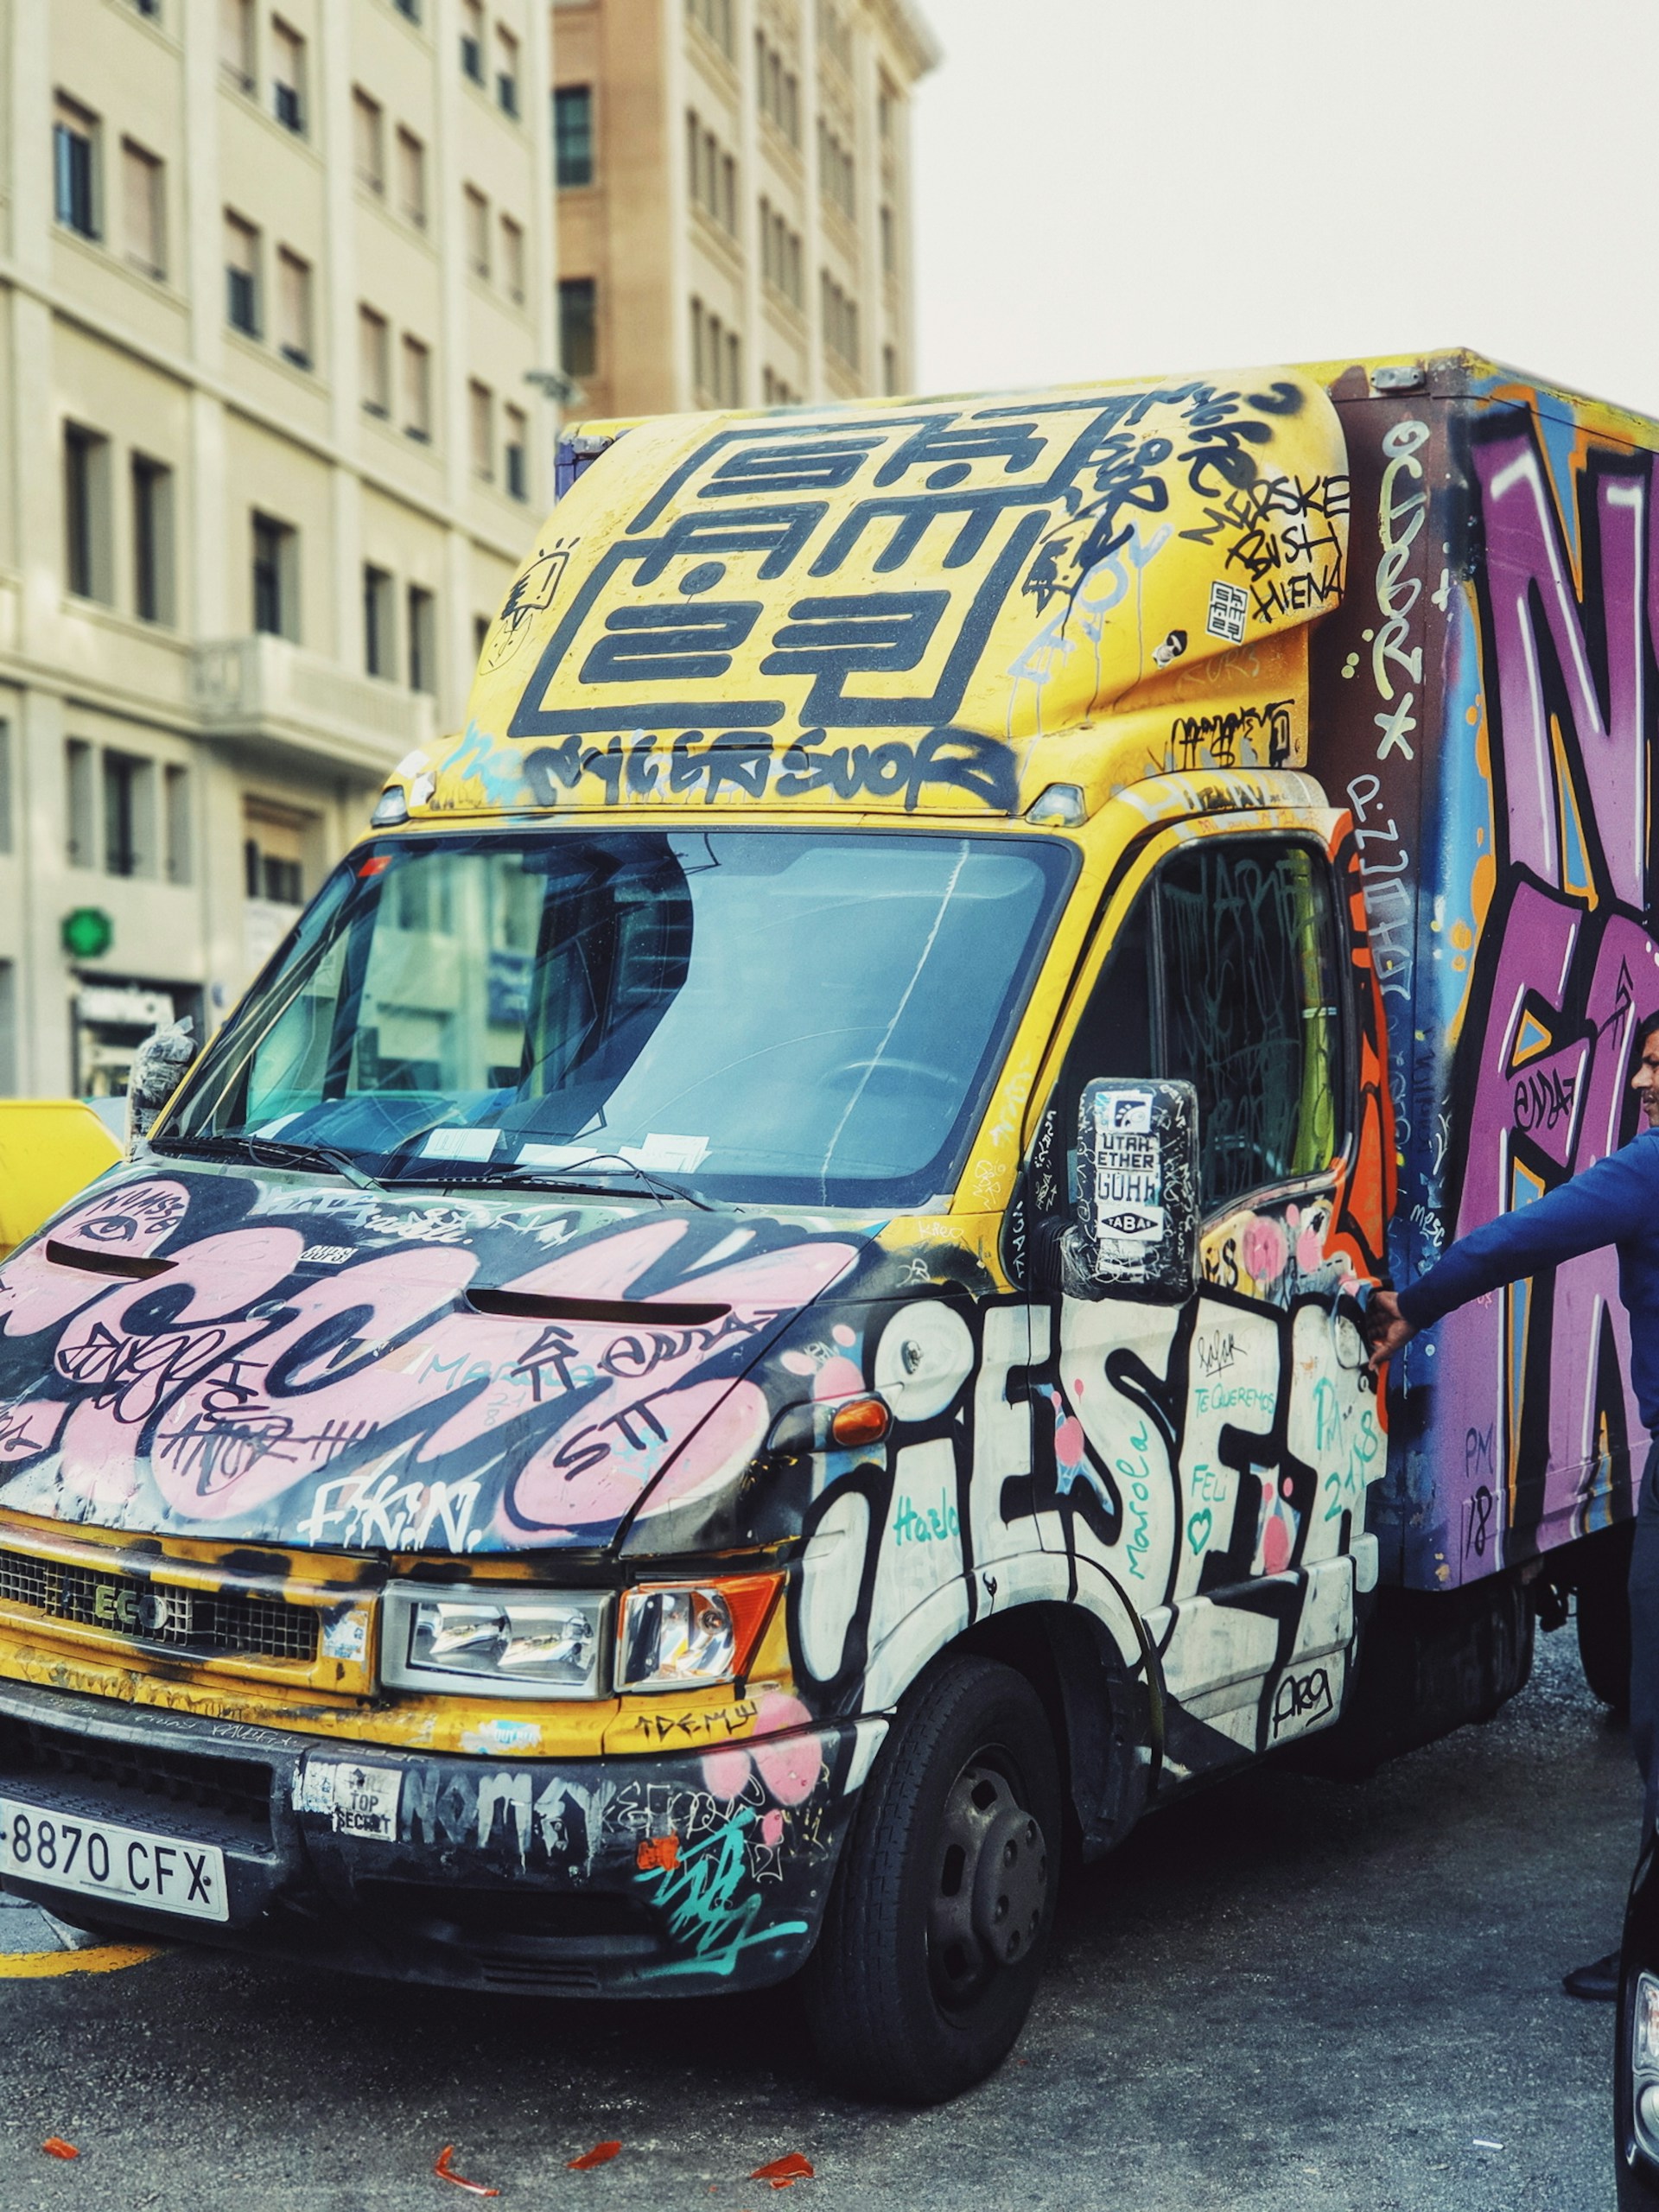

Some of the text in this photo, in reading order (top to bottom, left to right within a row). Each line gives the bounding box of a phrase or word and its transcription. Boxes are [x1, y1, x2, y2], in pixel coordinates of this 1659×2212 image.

[1097, 1152, 1154, 1169] ETHER
[350, 1792, 379, 1812] TOP
[12, 1814, 211, 1904] 8870 CFX
